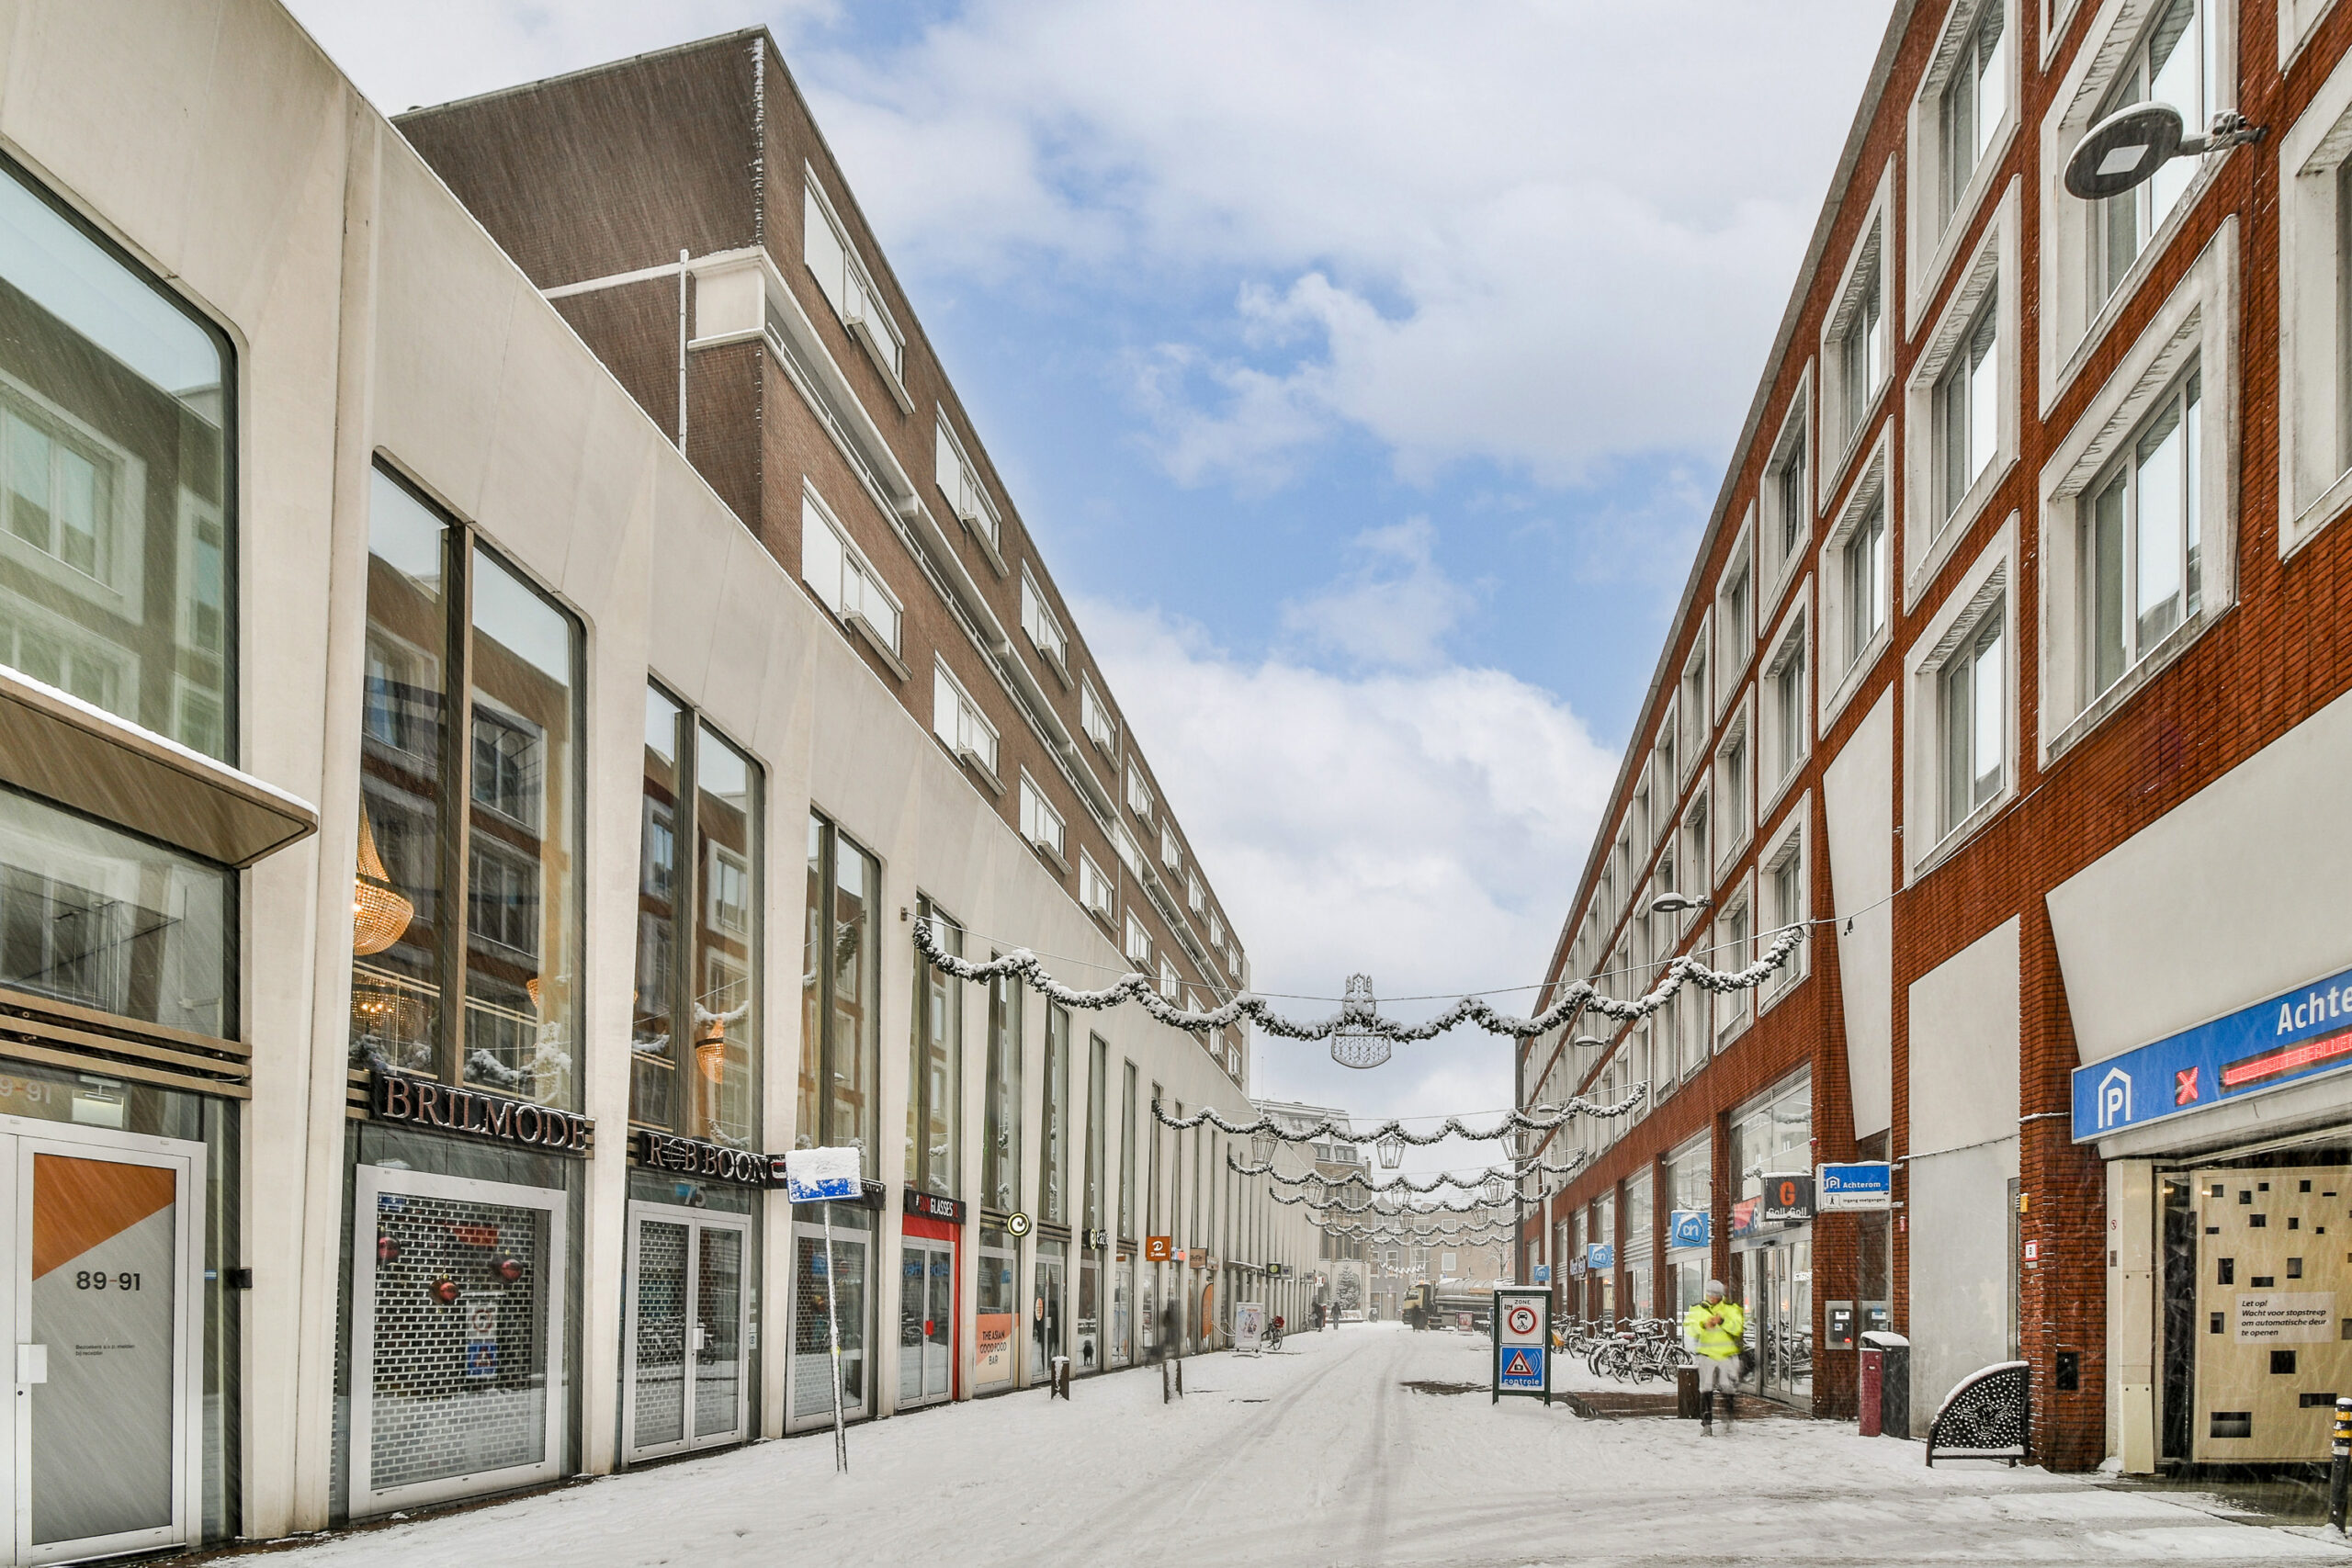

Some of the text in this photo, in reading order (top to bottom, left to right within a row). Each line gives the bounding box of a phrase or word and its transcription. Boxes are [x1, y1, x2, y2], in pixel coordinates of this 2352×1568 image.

[2277, 986, 2352, 1035] Achte
[382, 1076, 586, 1150] BRILMODE
[701, 1145, 768, 1184] BOON
[1780, 1181, 1796, 1205] G
[76, 1270, 141, 1291] 89-91
[2255, 1300, 2267, 1309] op!
[2242, 1309, 2267, 1317] Wacht
[2286, 1309, 2326, 1317] stopstreep
[2255, 1318, 2308, 1326] automatische
[2309, 1317, 2327, 1325] deur
[982, 1330, 1005, 1341] THE ASIAN
[2250, 1329, 2278, 1337] openen
[979, 1343, 994, 1354] GOOD
[989, 1355, 999, 1366] BAR
